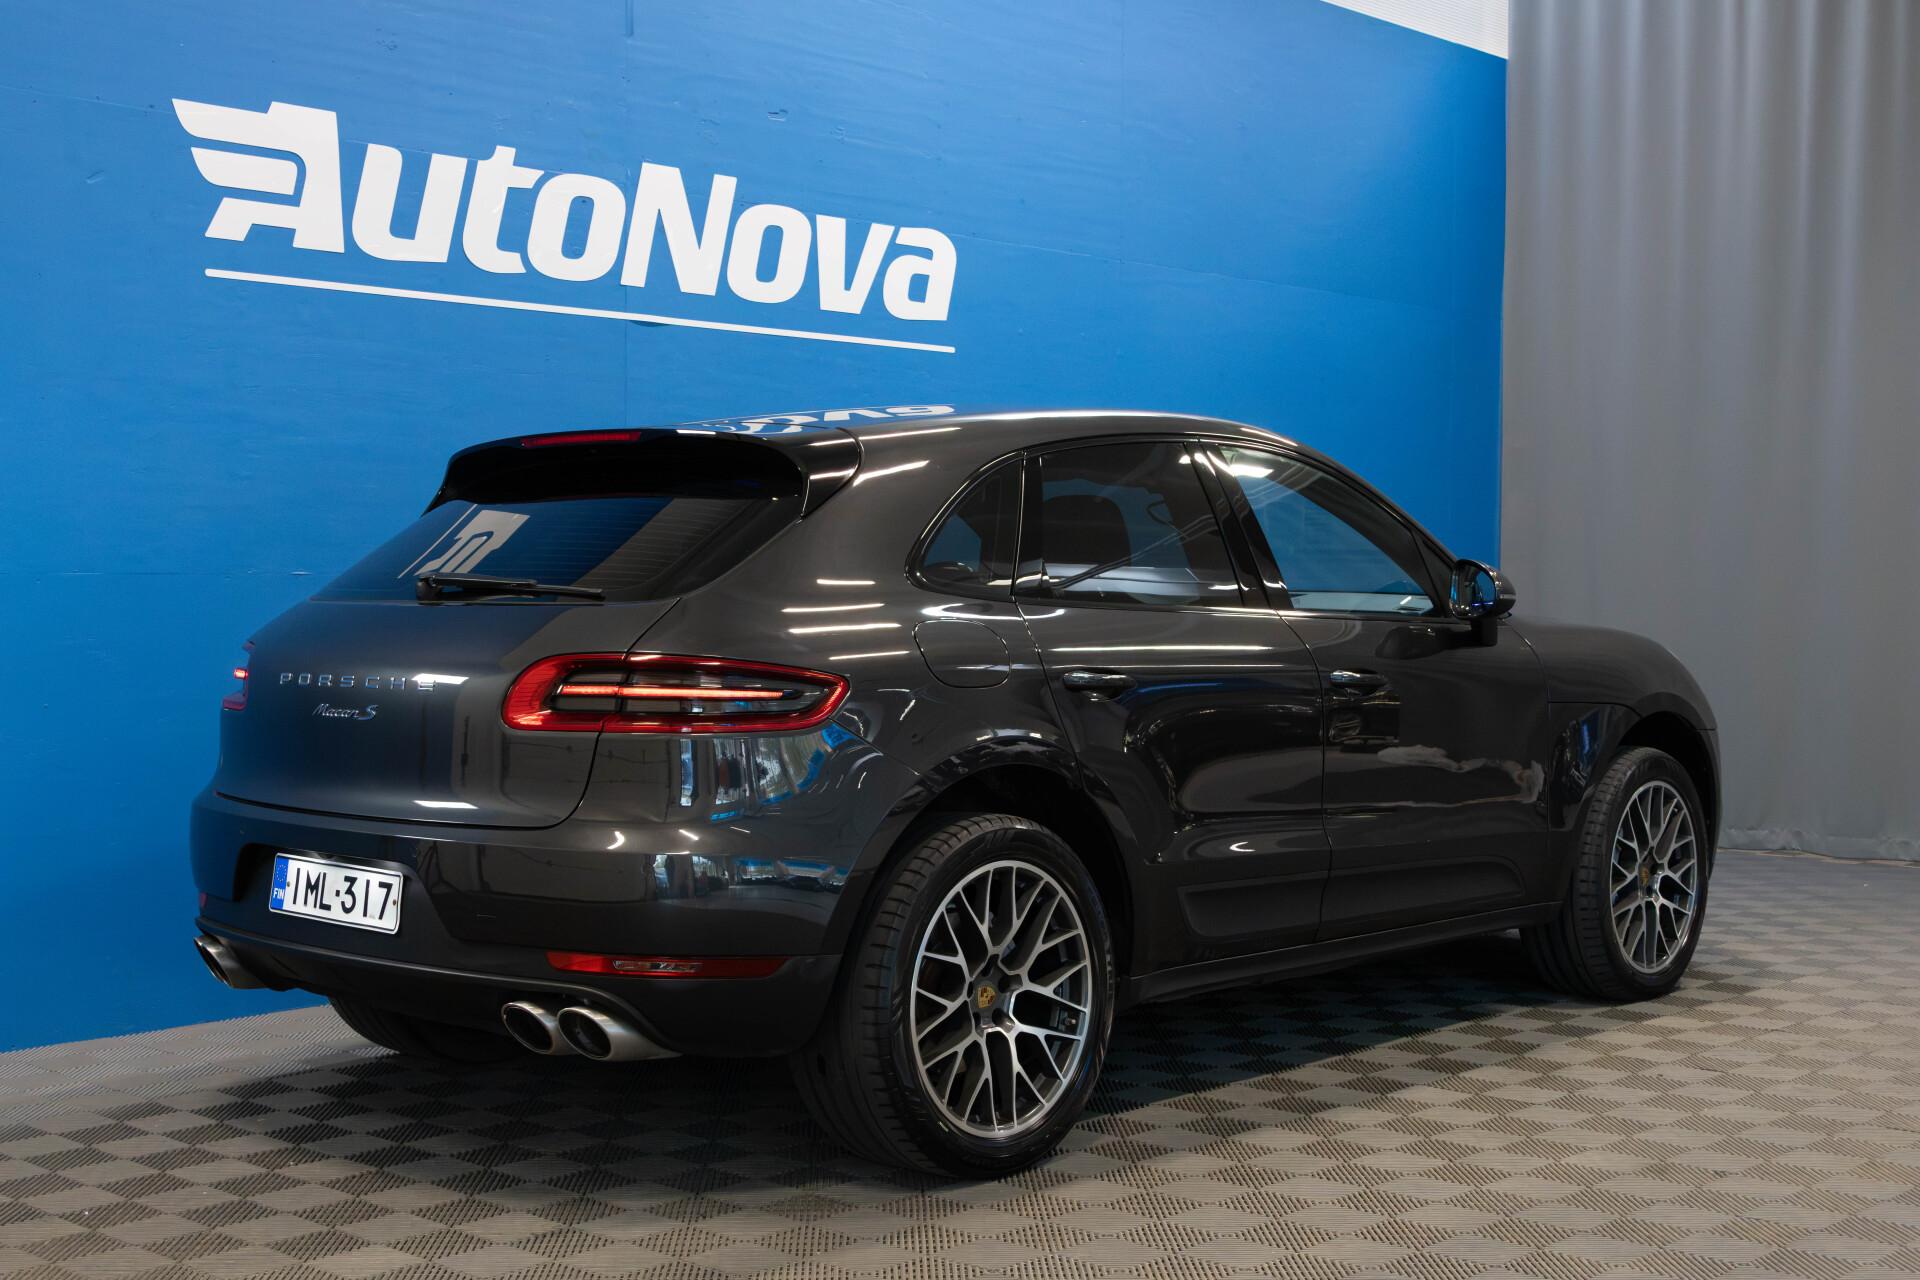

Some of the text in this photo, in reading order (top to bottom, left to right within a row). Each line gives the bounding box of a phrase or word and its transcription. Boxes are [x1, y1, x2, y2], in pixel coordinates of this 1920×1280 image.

[172, 99, 957, 320] AutoNova
[280, 672, 436, 692] PORSCHE
[312, 703, 379, 720] Macan S
[273, 888, 285, 900] FIN
[292, 867, 394, 920] IML-317
